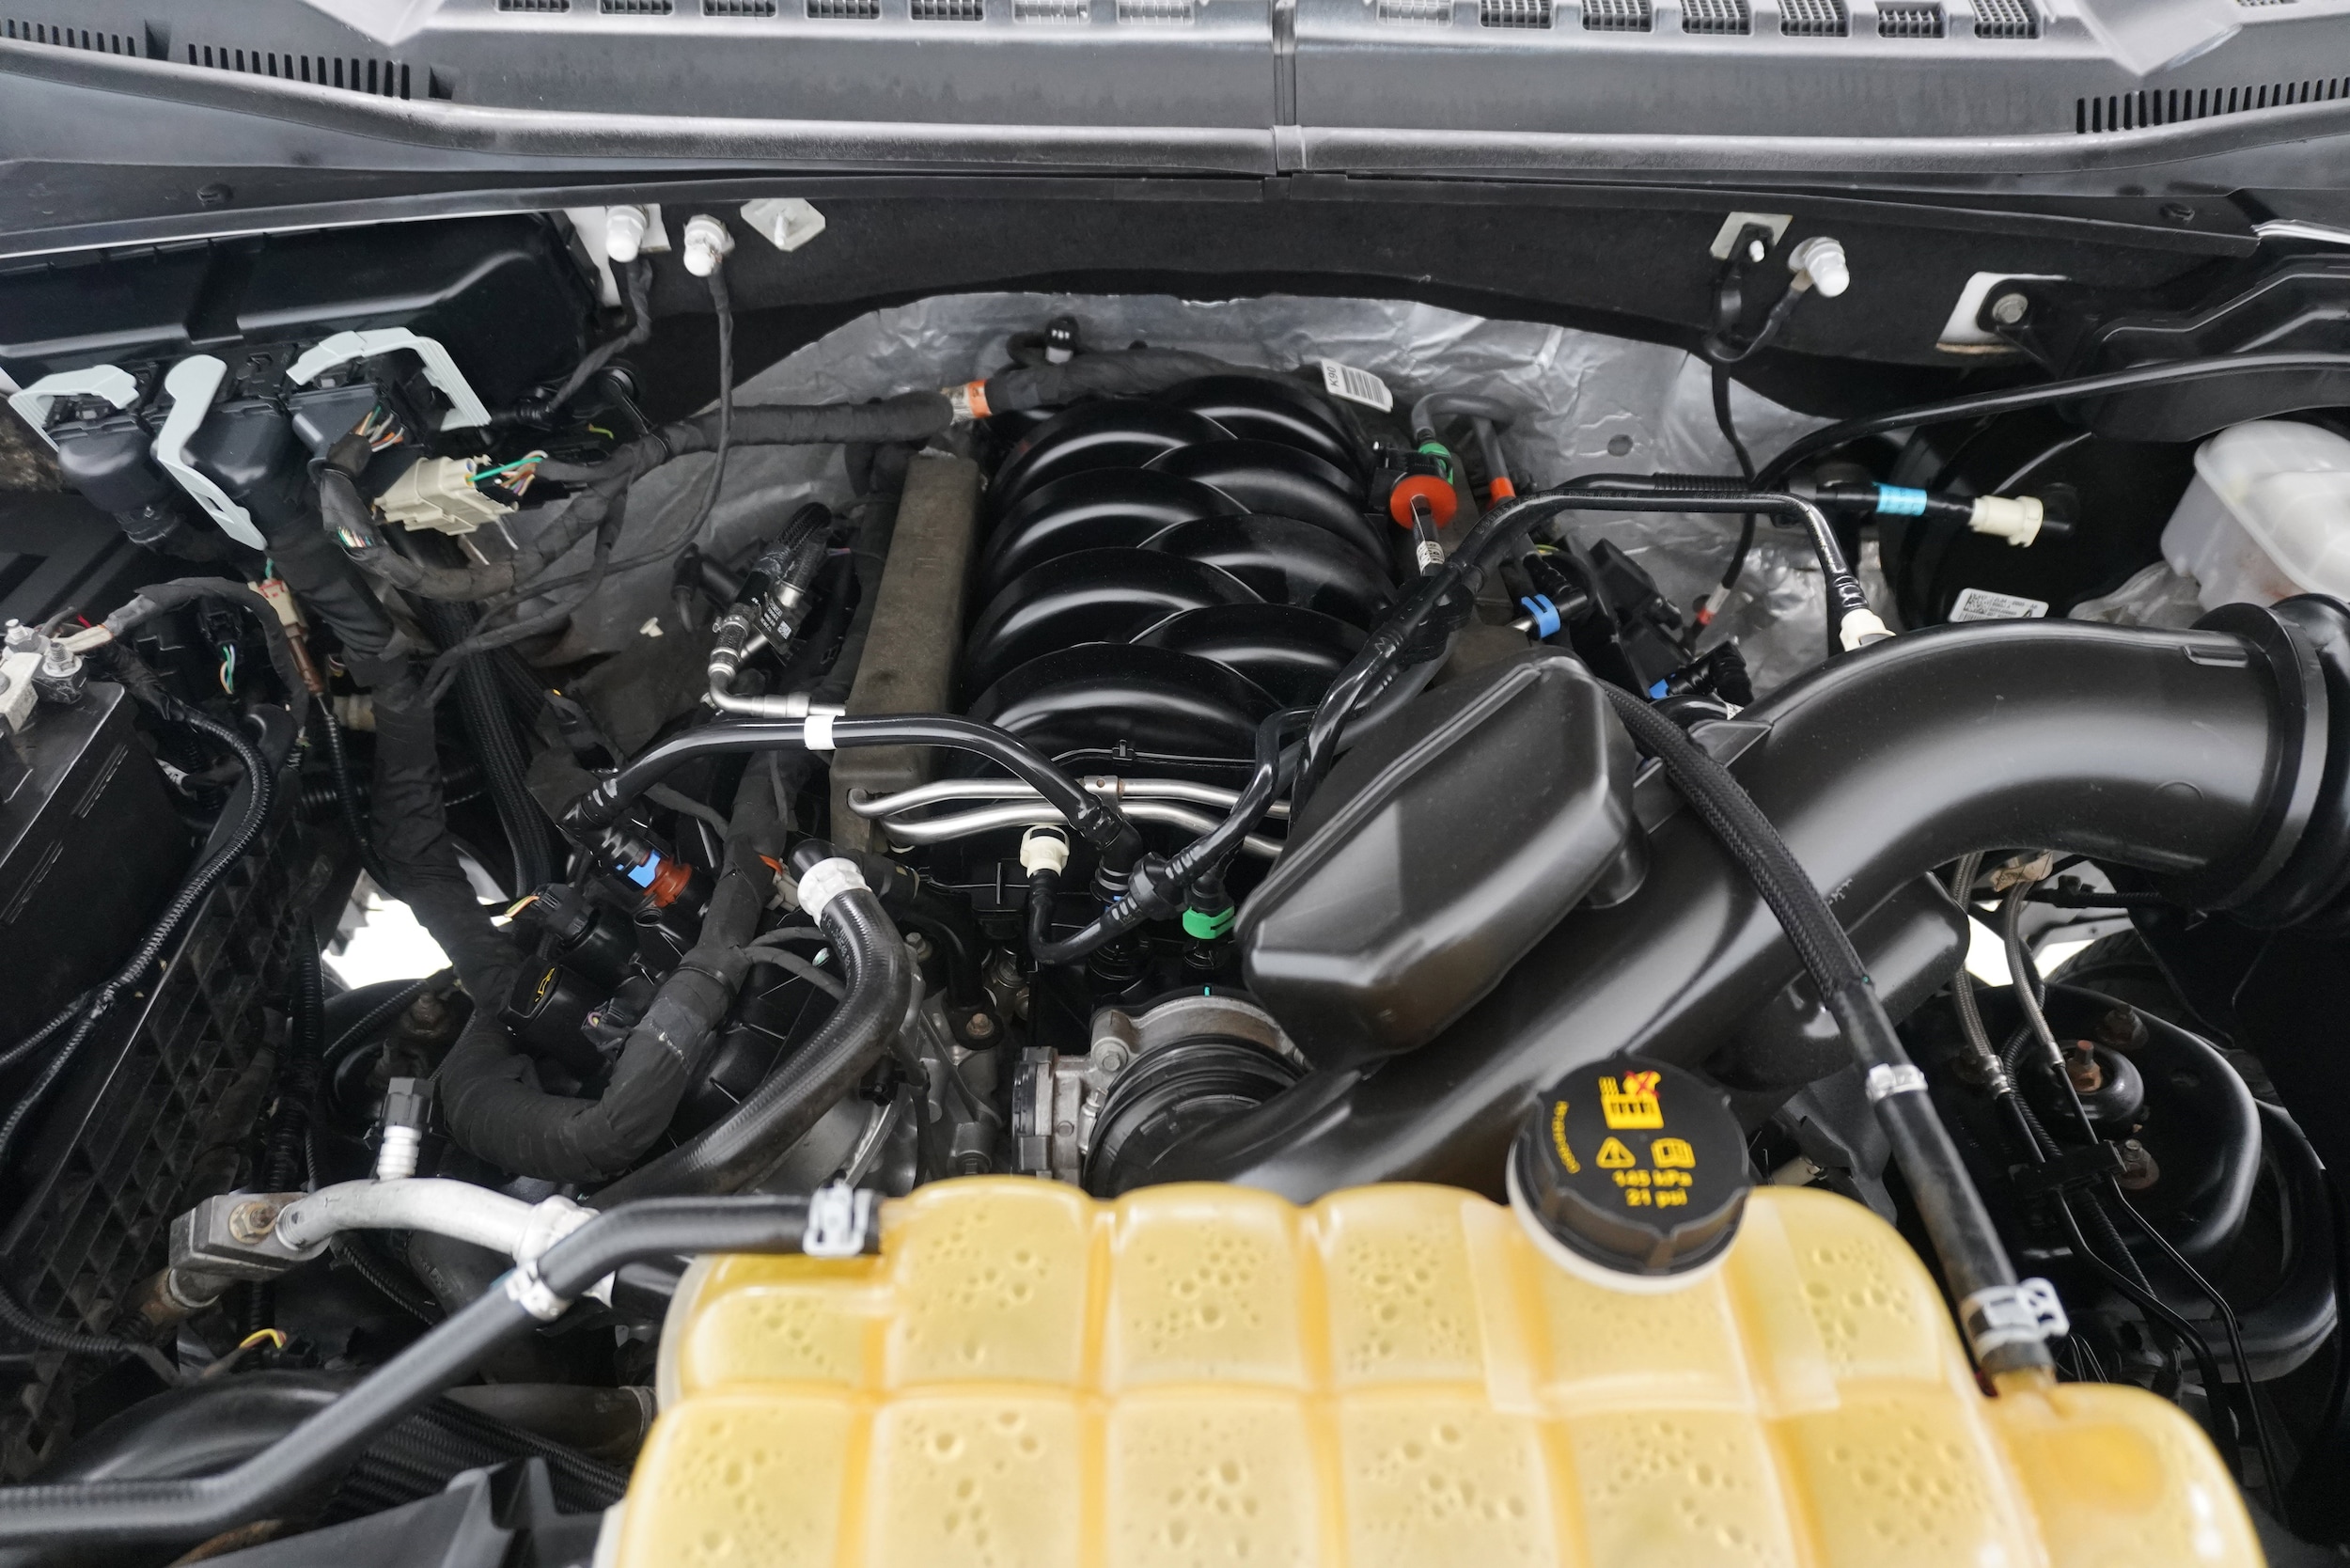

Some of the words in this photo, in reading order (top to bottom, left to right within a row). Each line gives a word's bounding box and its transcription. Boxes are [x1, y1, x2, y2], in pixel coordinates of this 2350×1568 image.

[1326, 366, 1340, 387] K90
[1611, 1168, 1652, 1187] 145
[1653, 1168, 1693, 1187] kPa
[1625, 1187, 1652, 1207] 21
[1654, 1188, 1688, 1209] psi
